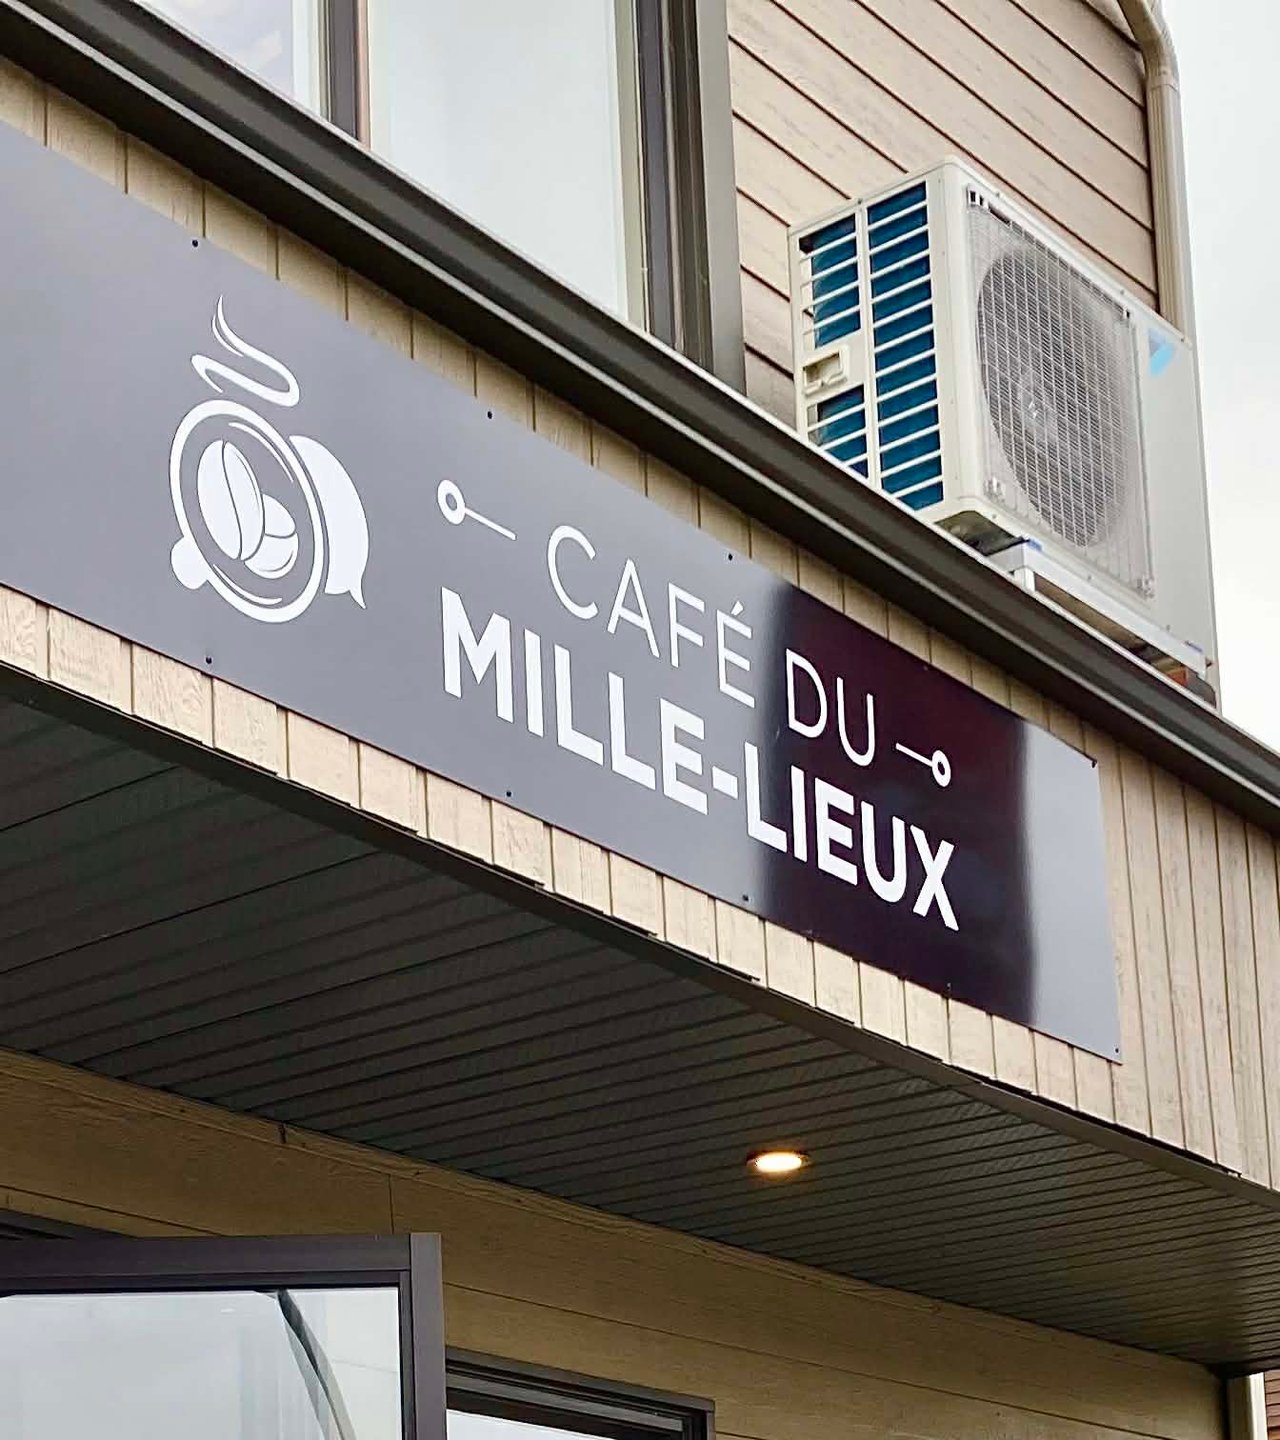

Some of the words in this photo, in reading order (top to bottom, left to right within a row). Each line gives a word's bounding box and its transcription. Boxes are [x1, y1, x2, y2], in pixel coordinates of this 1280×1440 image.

[440, 586, 960, 932] MILLE-LIEUX
[547, 524, 755, 709] CAFÉ
[784, 647, 877, 768] DU
